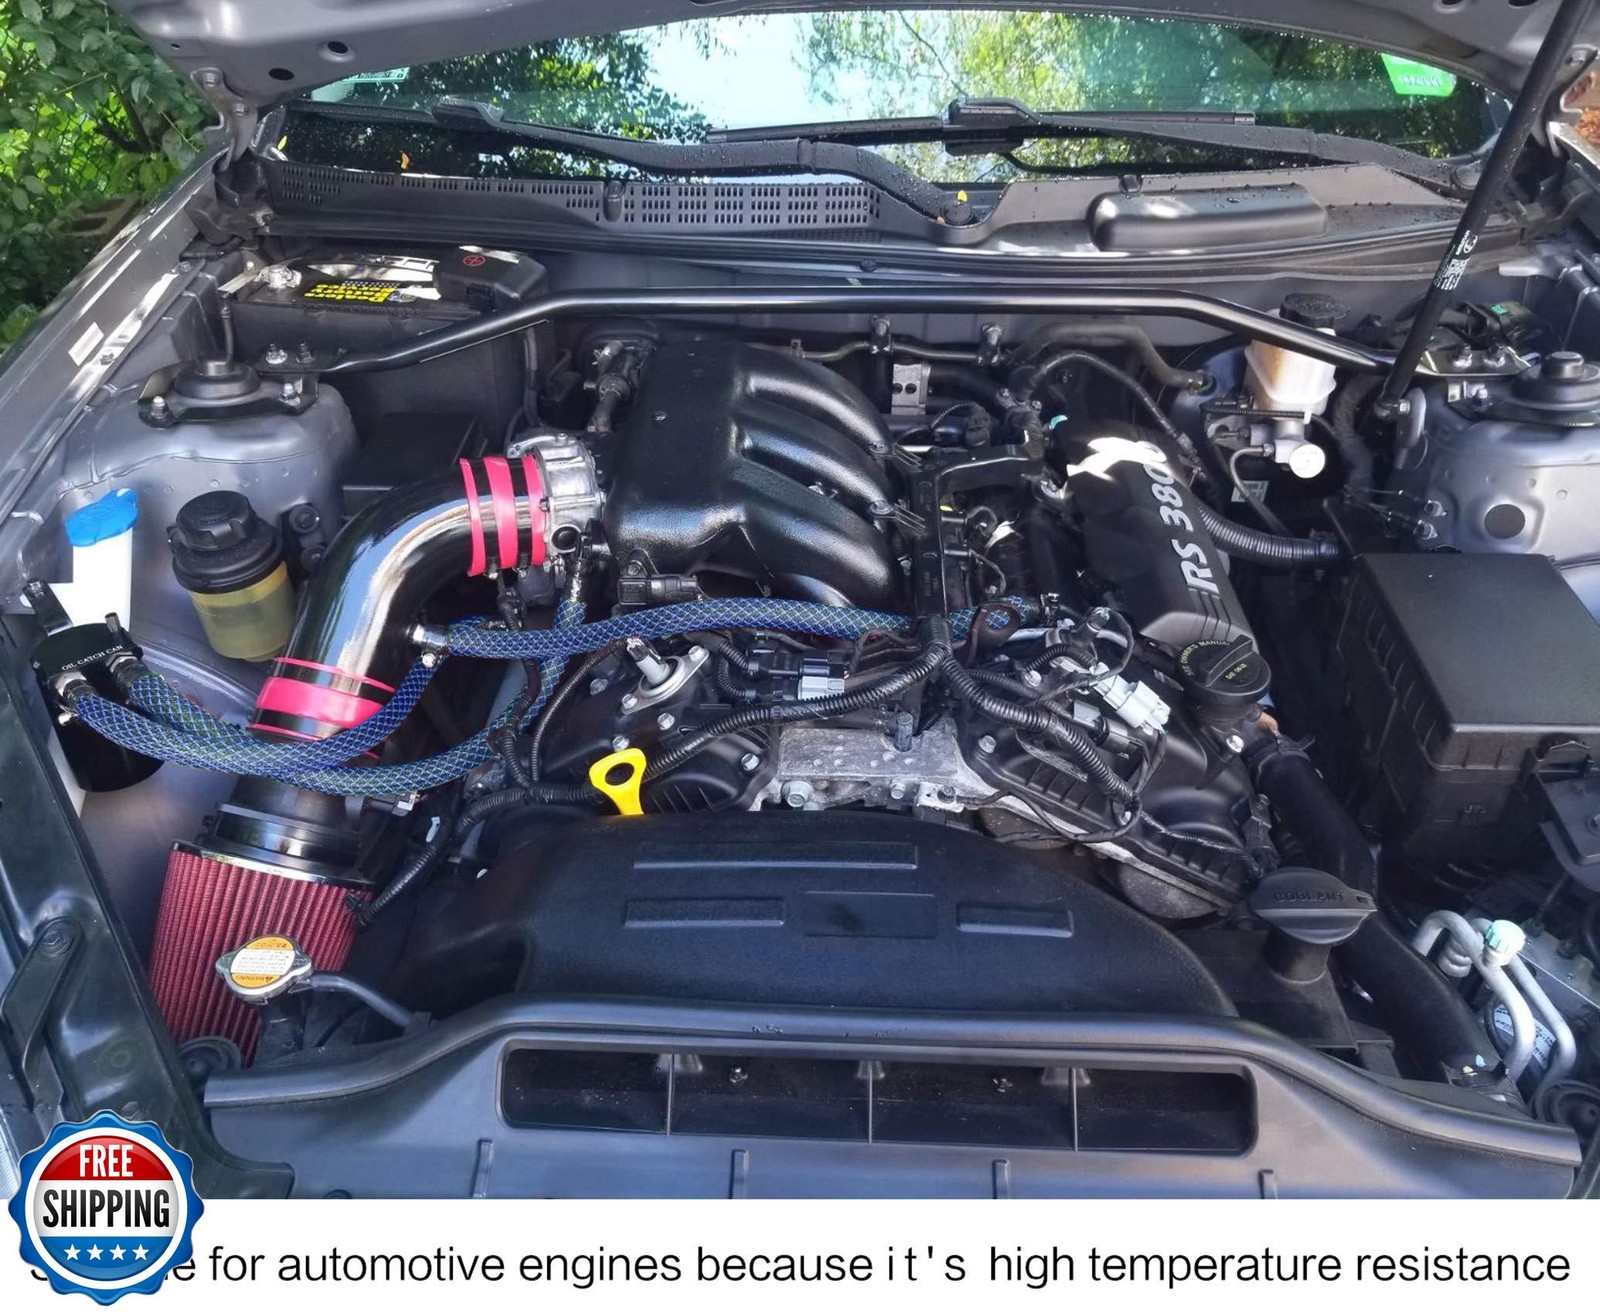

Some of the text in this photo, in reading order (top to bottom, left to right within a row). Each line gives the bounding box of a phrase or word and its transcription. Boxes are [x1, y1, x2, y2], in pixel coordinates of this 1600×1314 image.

[1171, 538, 1220, 594] RS
[61, 644, 124, 671] OIL CATCH CAN
[1273, 891, 1345, 902] COOLANT
